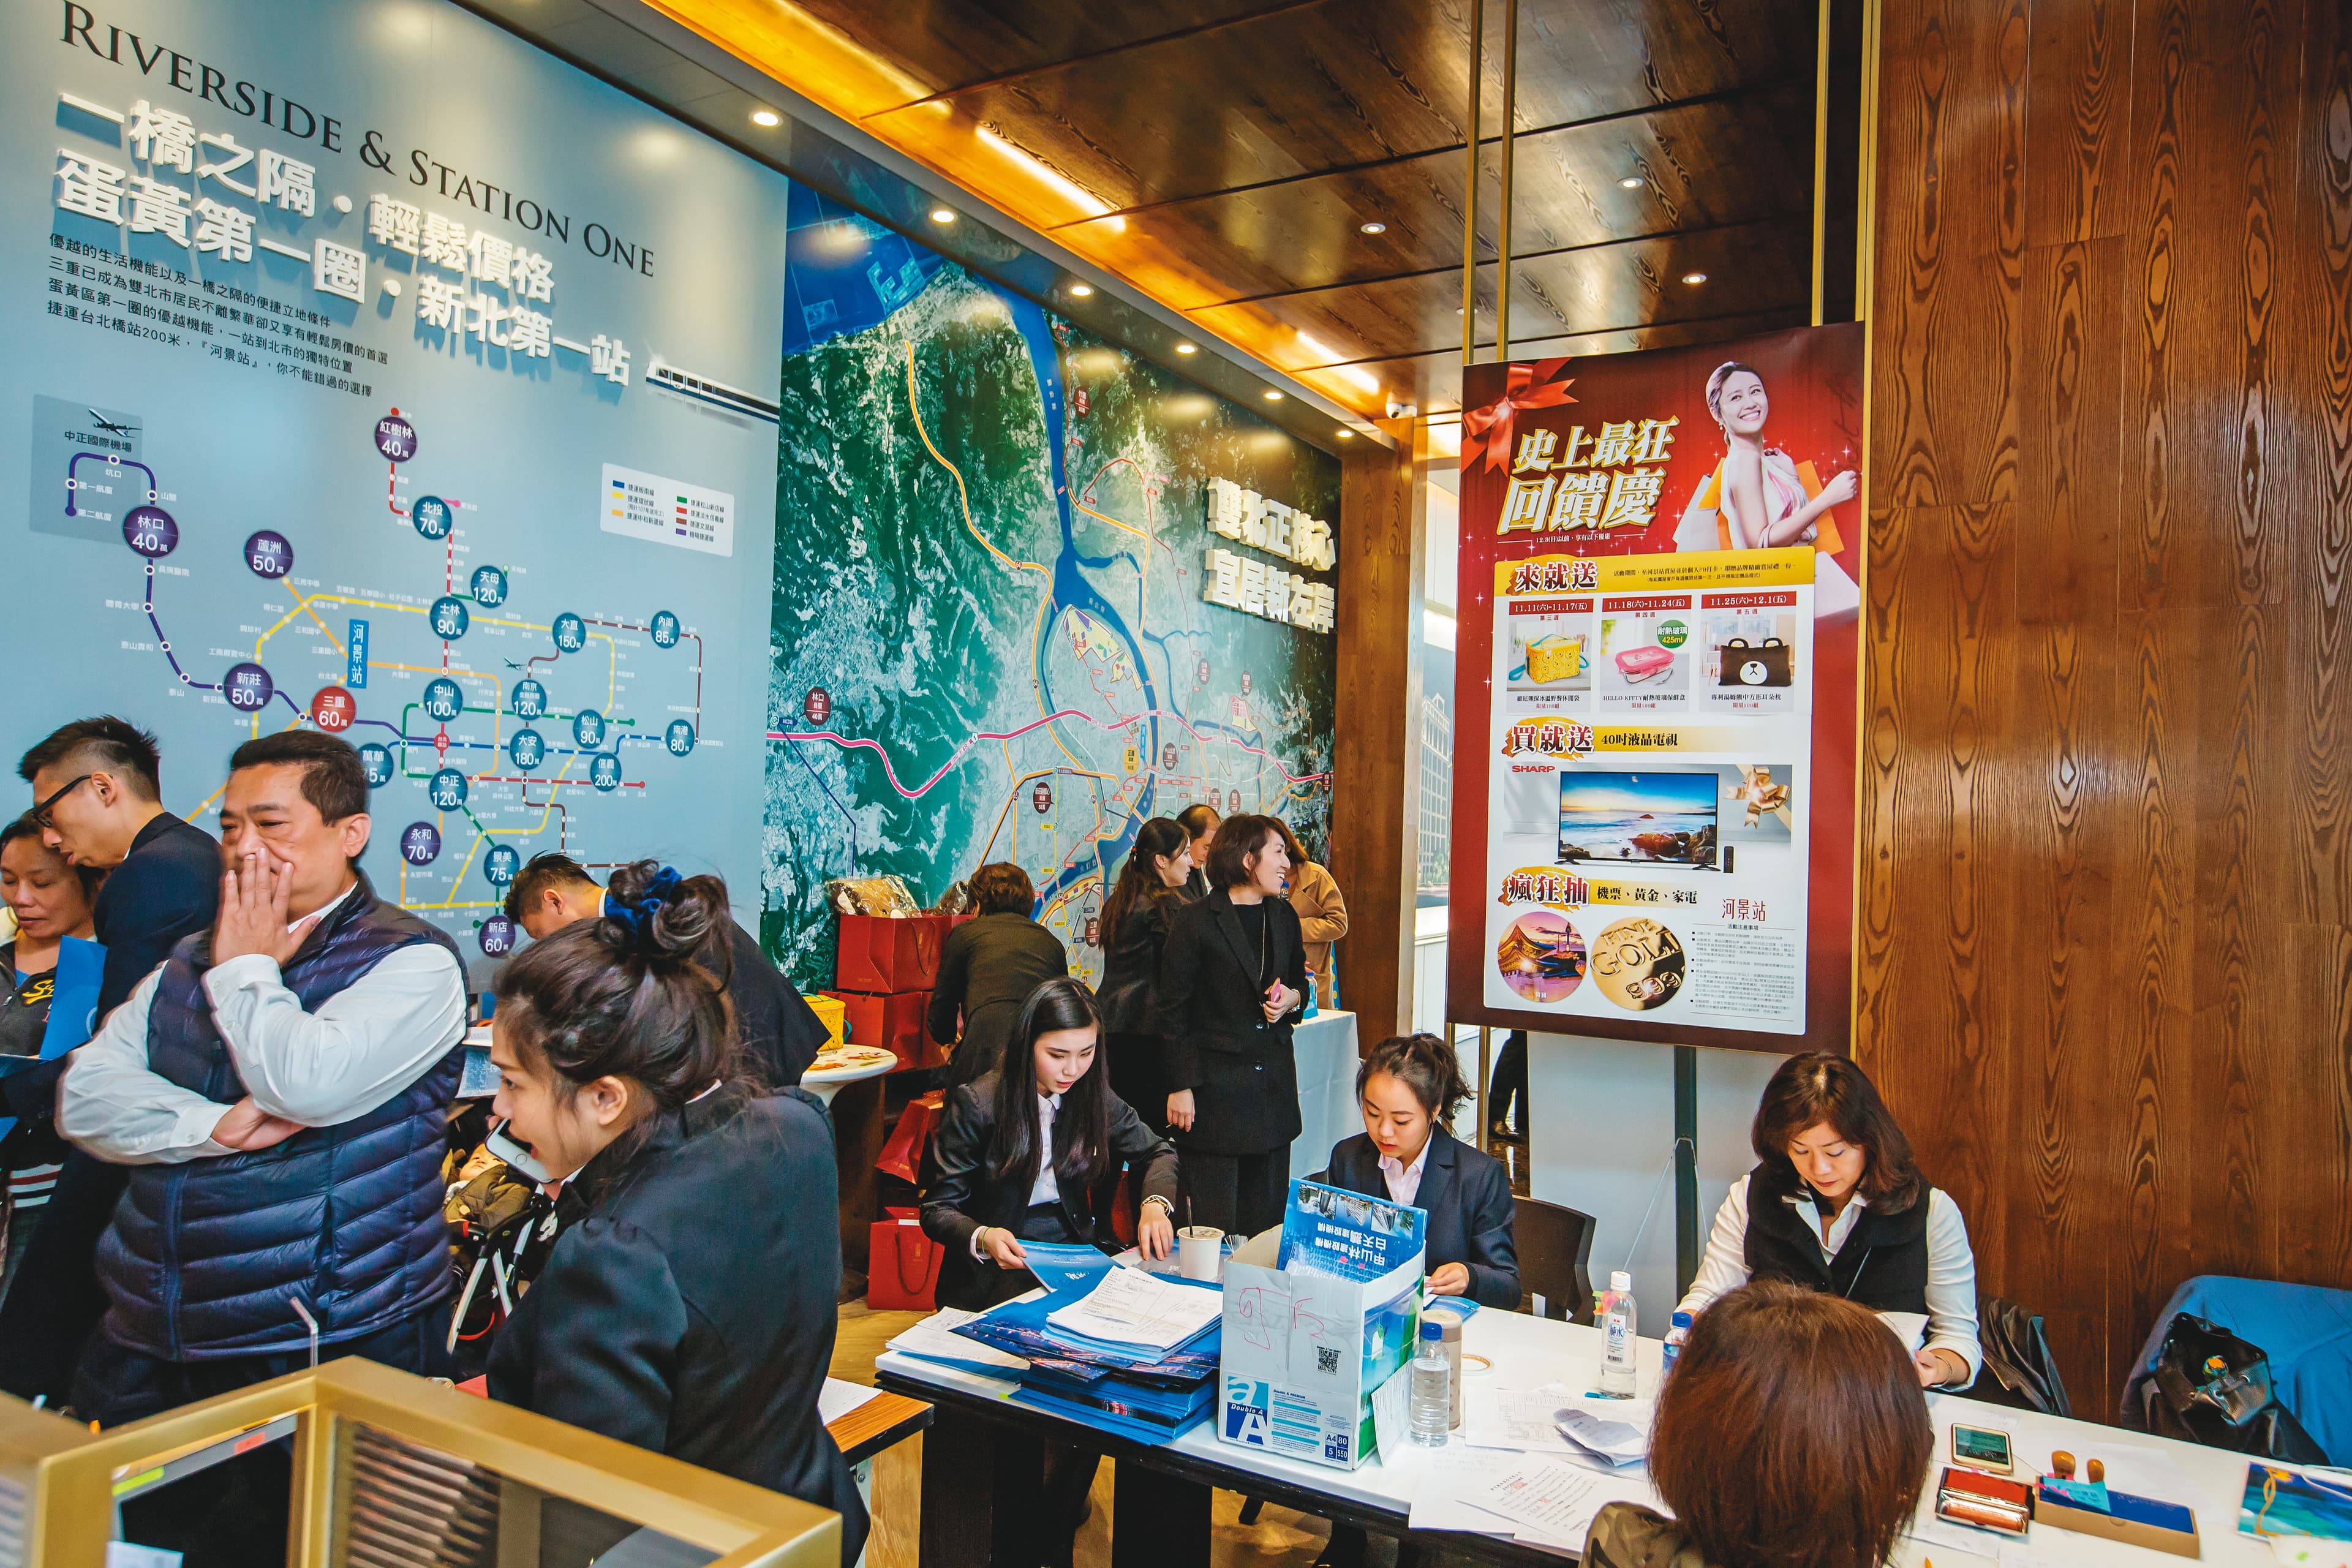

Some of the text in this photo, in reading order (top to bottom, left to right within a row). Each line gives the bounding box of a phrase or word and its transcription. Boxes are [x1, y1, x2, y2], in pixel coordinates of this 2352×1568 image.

[59, 2, 655, 278] RIVERSIDE & STATION ONE
[50, 233, 331, 328] 優越的生活機能以及一橋之隔的便捷立地條件
[48, 255, 388, 366] 三重已成為雙北市居民不離繁華卻又享有輕鬆房價的首選
[379, 420, 413, 440] 紅樹林
[64, 429, 132, 453] 中正國際機場
[1512, 415, 1681, 475] 史上最狂
[1496, 465, 1667, 536] 回饋慶
[422, 501, 443, 516] 北投
[137, 514, 165, 531] 林口
[257, 538, 282, 555] 蘆洲
[480, 571, 500, 585] 天母
[1514, 560, 1599, 593] 來就送
[1203, 548, 1335, 635] 宜居新左岸
[439, 601, 461, 616] 士林
[560, 617, 579, 631] 大直
[658, 616, 674, 628] 內湖
[1657, 626, 1689, 636] 耐熱玻璃
[351, 624, 364, 685] 河景站
[236, 671, 262, 687] 新莊
[522, 681, 537, 691] 南京
[434, 684, 454, 698] 中山
[812, 692, 824, 702] 林口
[323, 695, 345, 709] 三重
[581, 715, 598, 727] 松山
[673, 725, 688, 736] 南港
[518, 734, 537, 747] 大安
[1510, 723, 1595, 755] 買就送
[1600, 732, 1678, 747] 40吋液晶電視
[362, 750, 385, 763] 萬華
[598, 758, 614, 770] 信義
[1512, 764, 1556, 773] SHARP
[439, 774, 459, 787] 中正
[410, 828, 432, 841] 永和
[492, 851, 512, 863] 景美
[1507, 872, 1591, 908] 瘋狂抽
[1597, 886, 1698, 905] 機票、黃金、家電
[1721, 898, 1766, 922] 河景站
[488, 921, 508, 933] 新店
[1314, 1236, 1386, 1267] 甲山林建設機構
[1231, 1403, 1256, 1413] Double
[1326, 1433, 1336, 1442] A4
[1338, 1436, 1348, 1445] 80
[1337, 1449, 1348, 1458] 550
